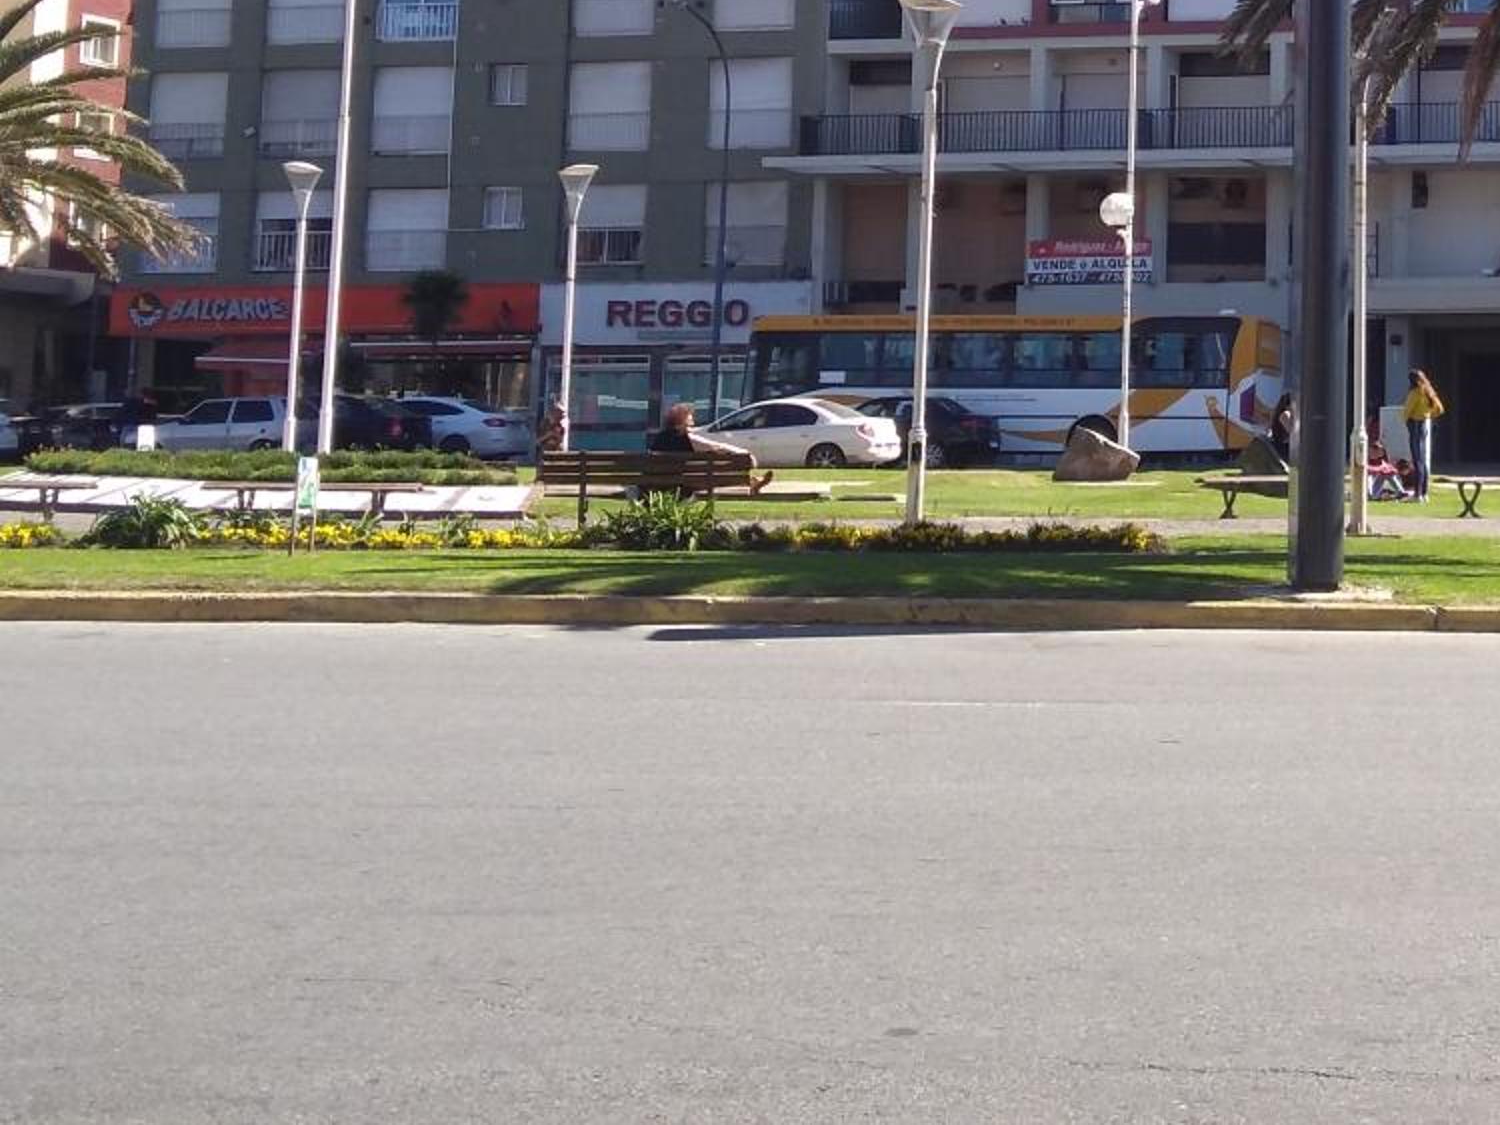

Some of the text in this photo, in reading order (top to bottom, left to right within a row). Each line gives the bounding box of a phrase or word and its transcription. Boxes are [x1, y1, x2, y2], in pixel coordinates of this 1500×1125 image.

[1033, 259, 1076, 270] VENDE
[1091, 258, 1147, 269] ALQULA
[167, 298, 287, 321] BALCARCE
